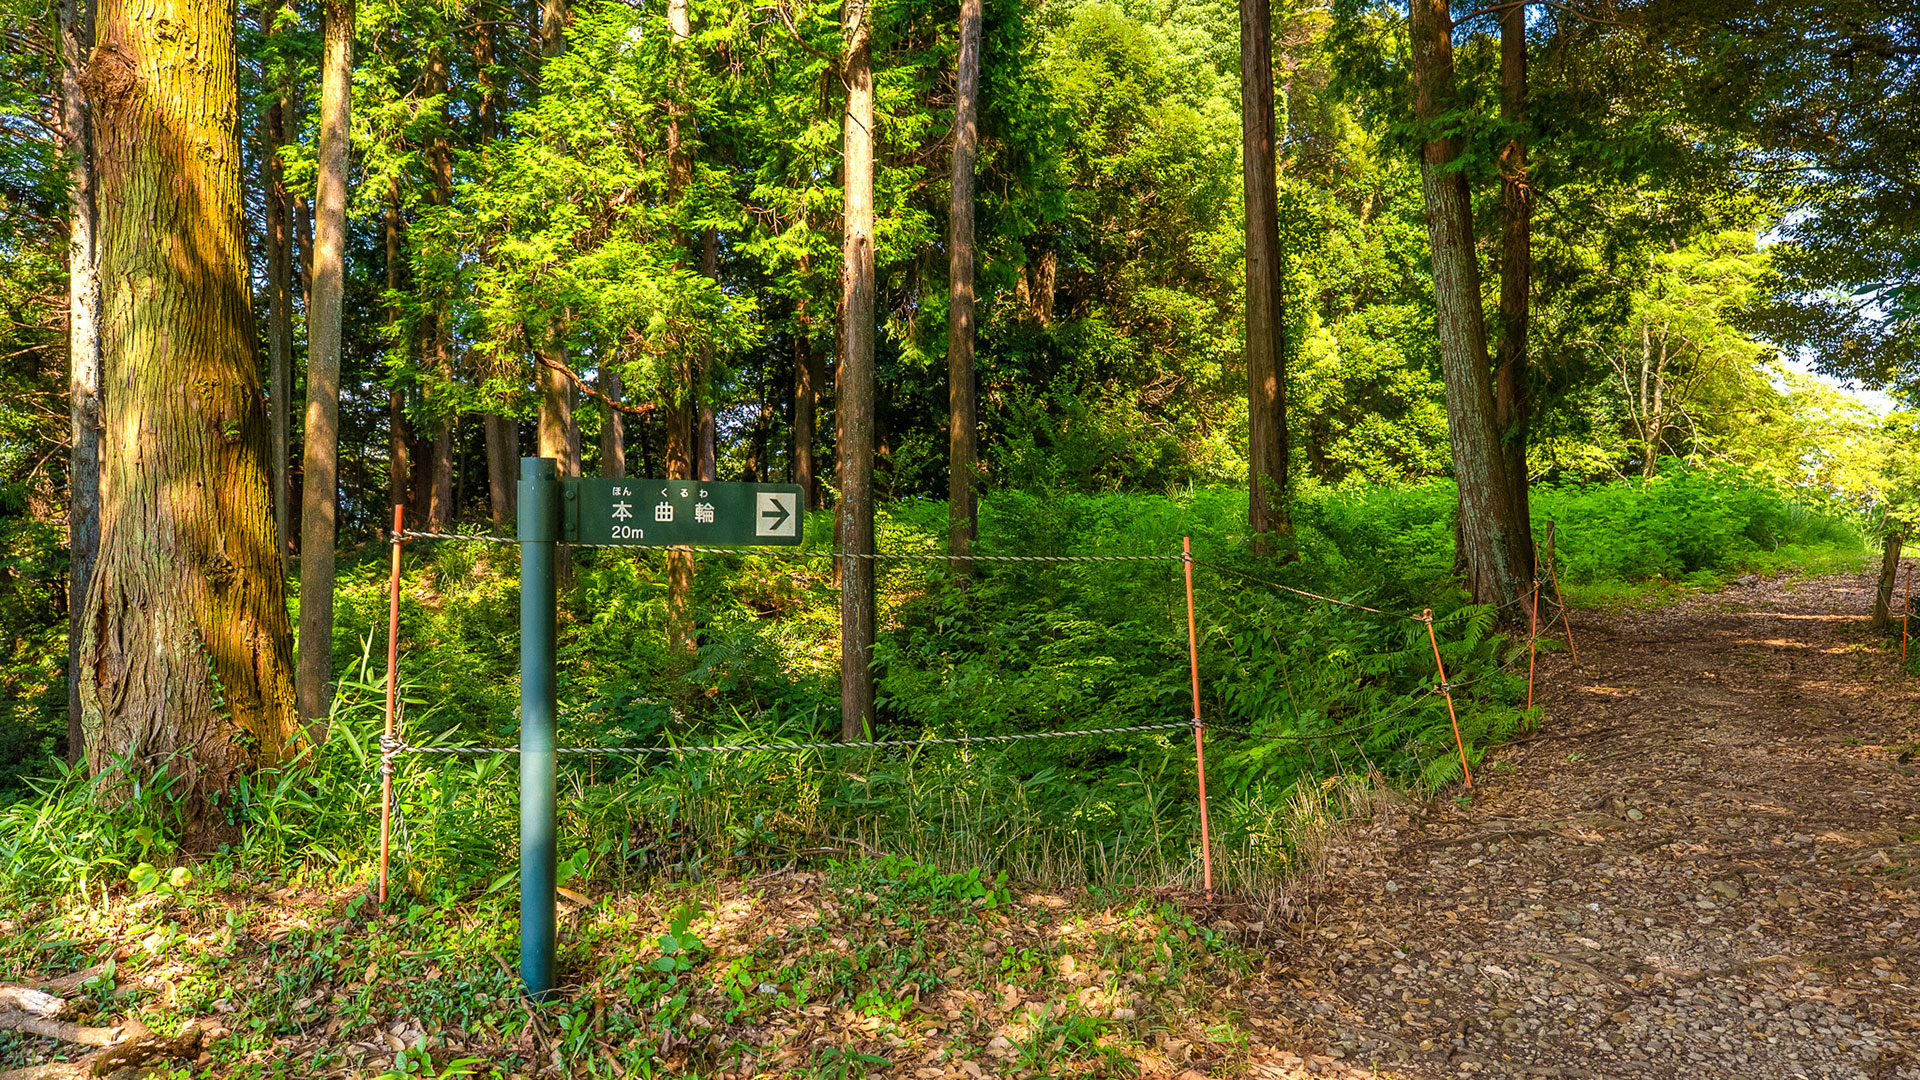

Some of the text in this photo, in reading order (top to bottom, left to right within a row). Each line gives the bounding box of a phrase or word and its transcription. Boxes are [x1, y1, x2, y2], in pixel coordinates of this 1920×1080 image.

[612, 486, 709, 498] ほん くるわ
[611, 500, 715, 524] 本曲輪
[611, 525, 644, 539] 20m
